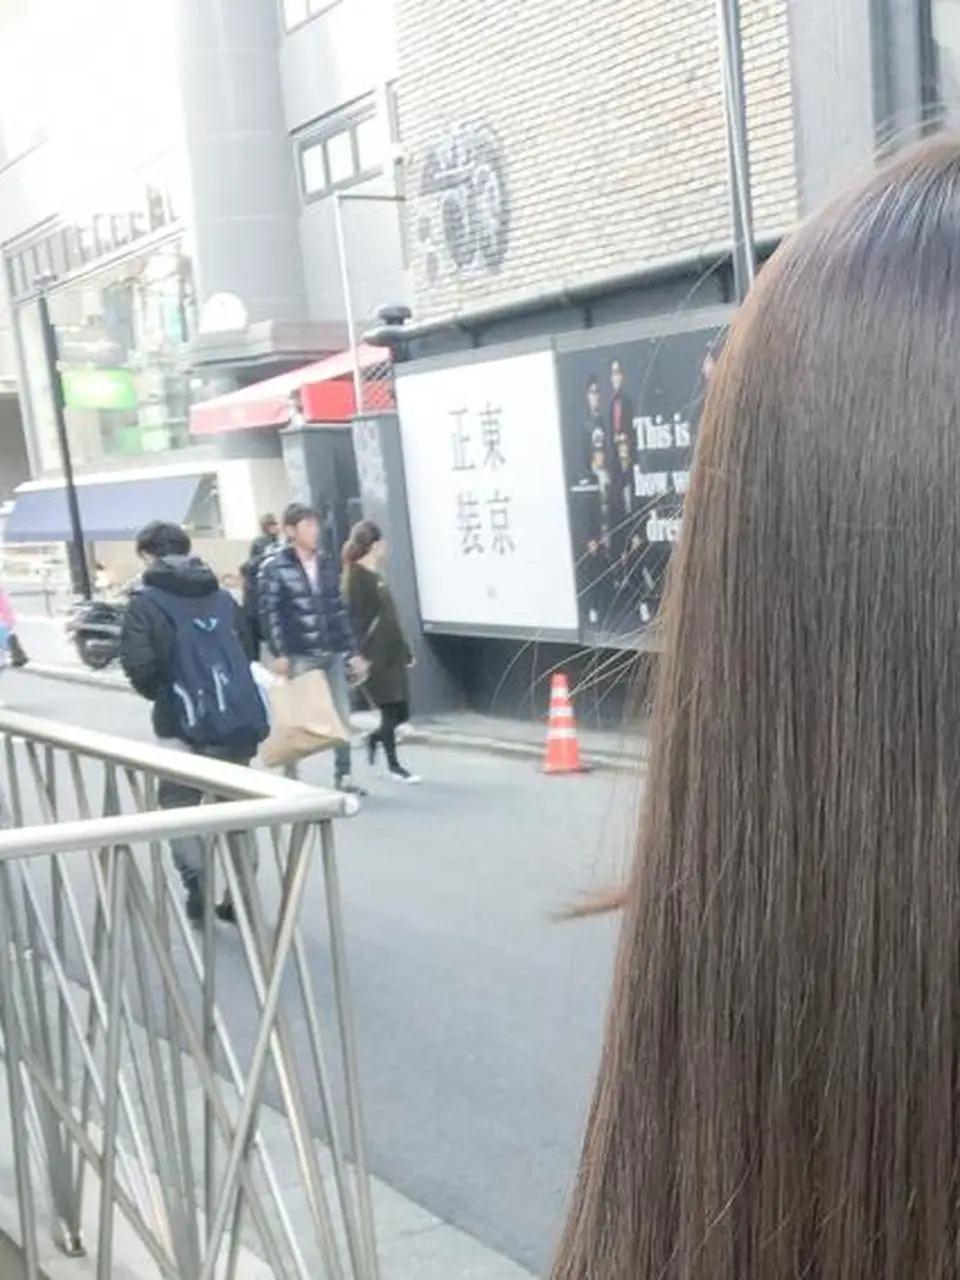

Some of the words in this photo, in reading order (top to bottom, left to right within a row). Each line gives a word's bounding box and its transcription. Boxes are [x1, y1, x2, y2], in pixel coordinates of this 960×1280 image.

[632, 414, 672, 451] This
[673, 412, 691, 448] is
[478, 401, 517, 556] 東京
[633, 464, 668, 497] how
[671, 470, 691, 494] w
